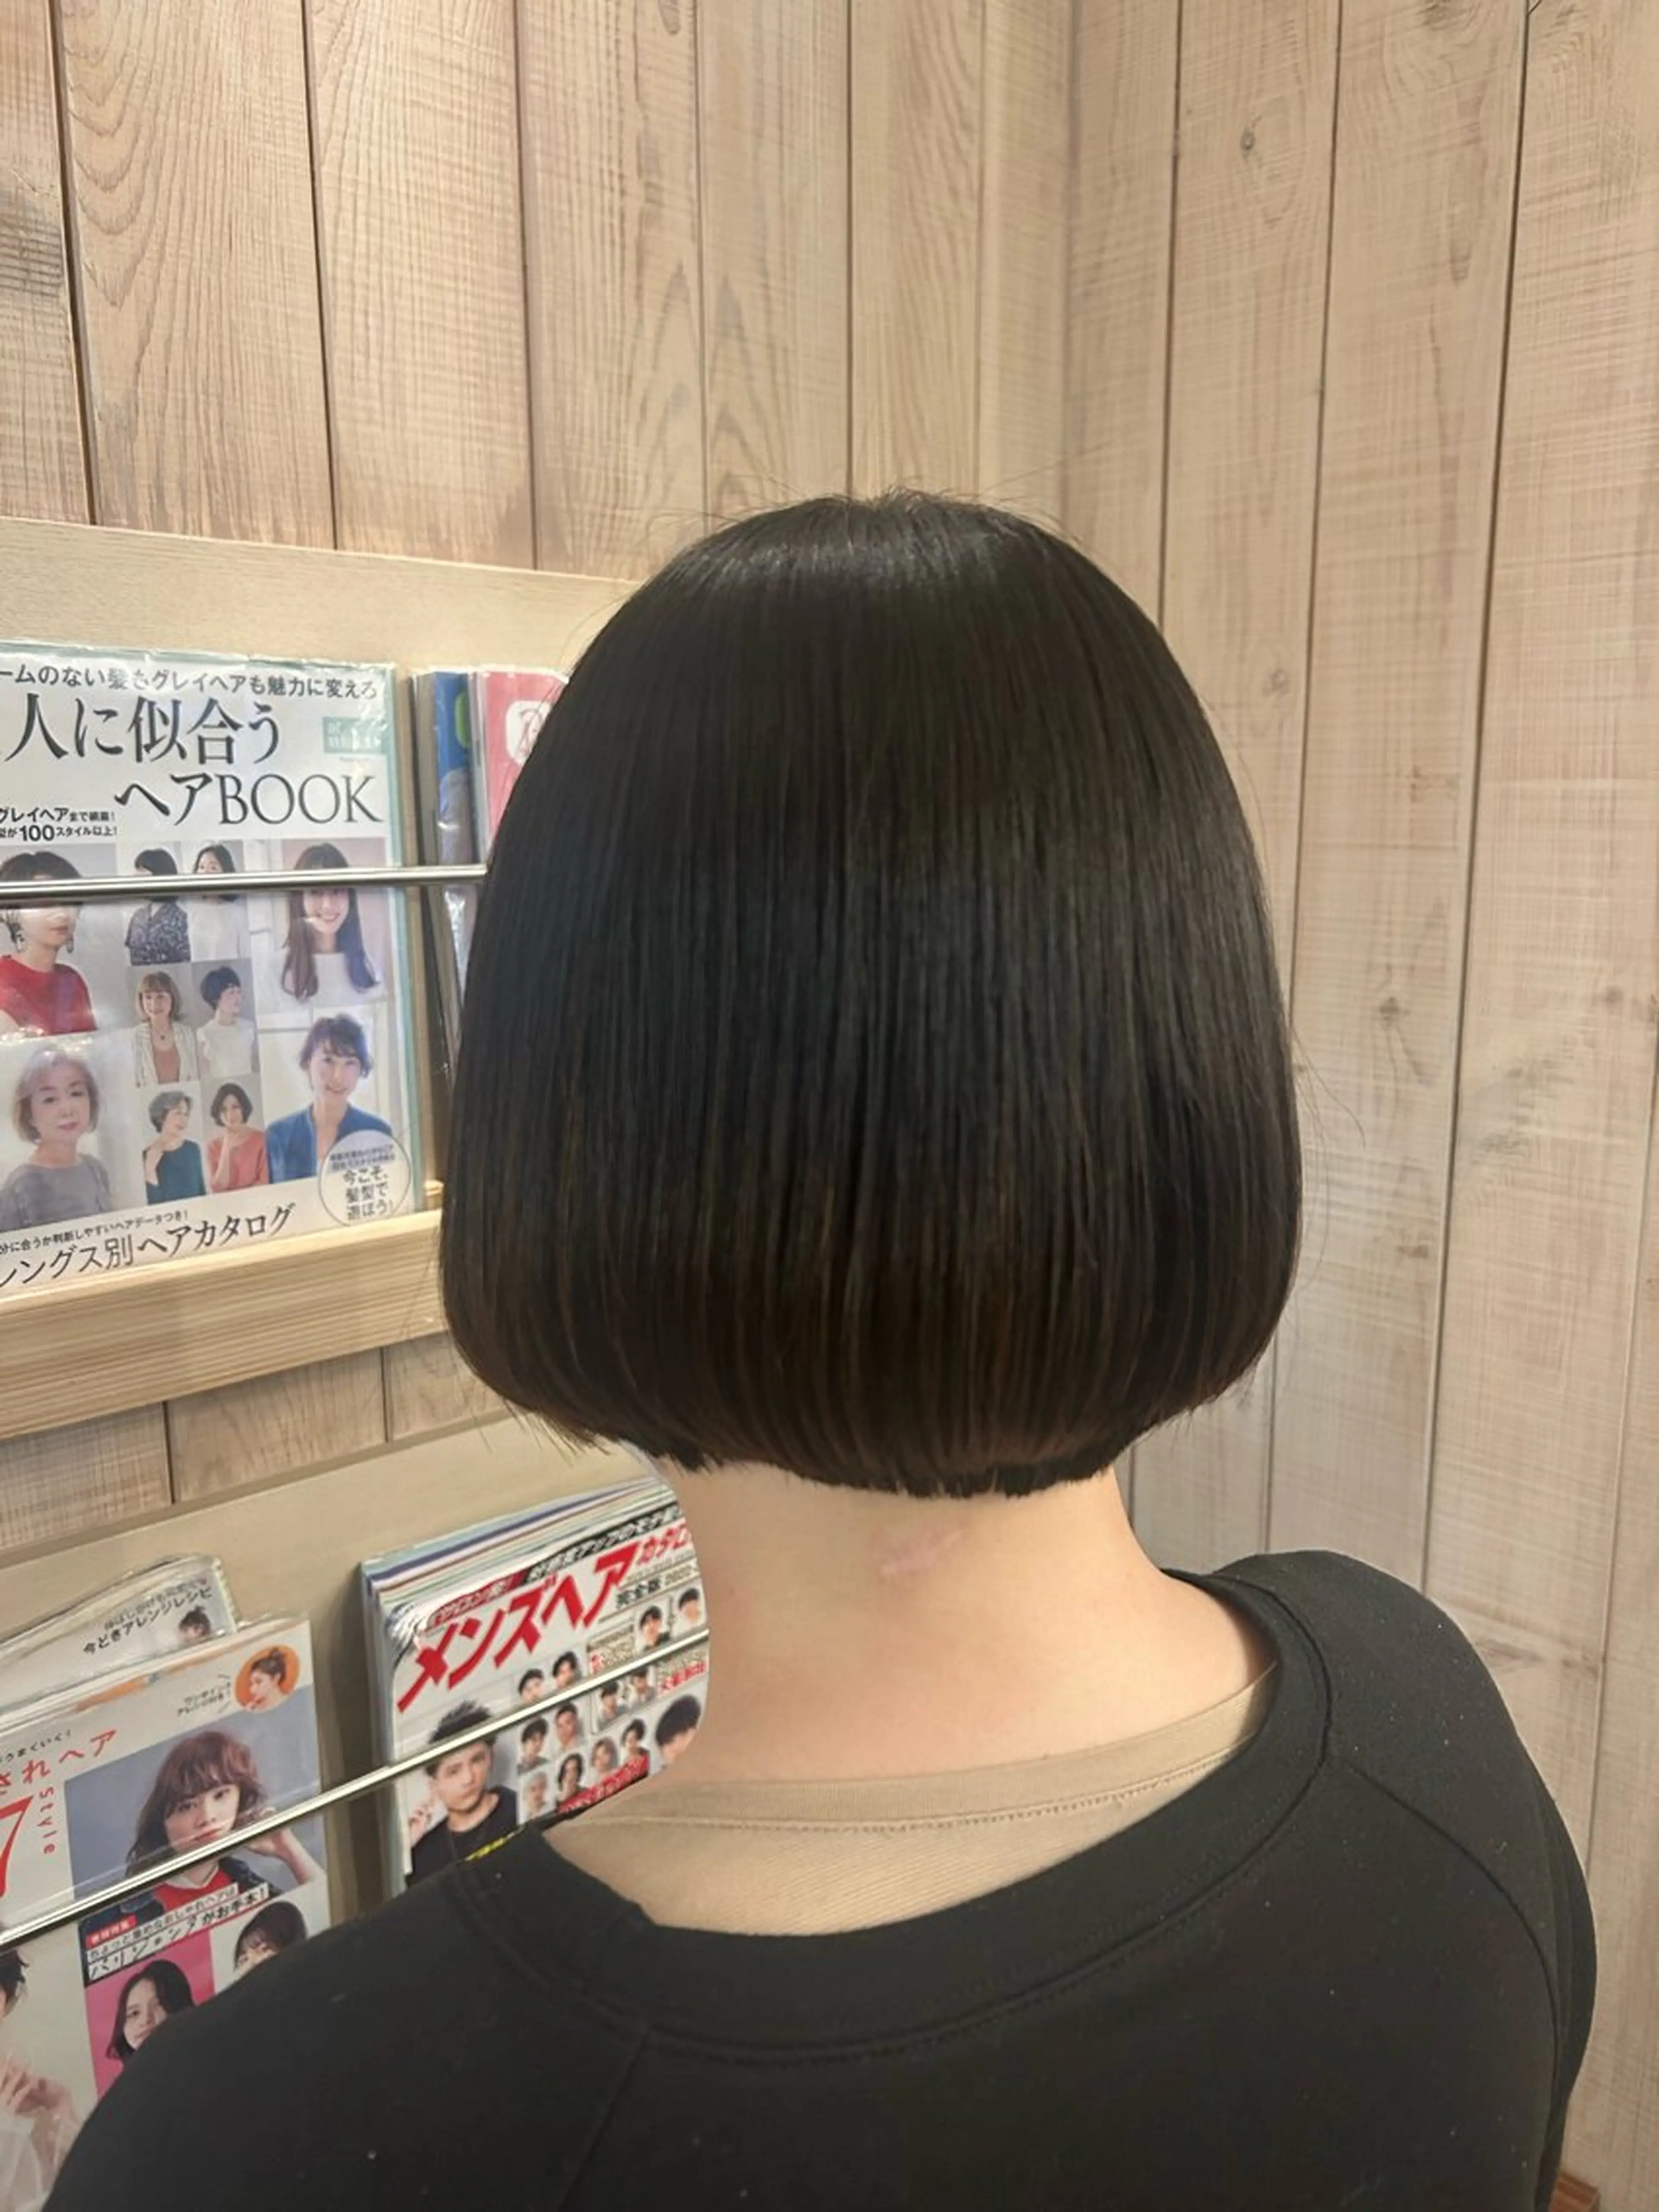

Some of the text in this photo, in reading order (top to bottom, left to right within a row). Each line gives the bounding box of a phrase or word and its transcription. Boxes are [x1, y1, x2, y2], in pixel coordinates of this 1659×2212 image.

[3, 693, 279, 765] 人に似合う
[114, 772, 385, 826] ヘアBOOK
[0, 1729, 71, 1764] うまくいく!
